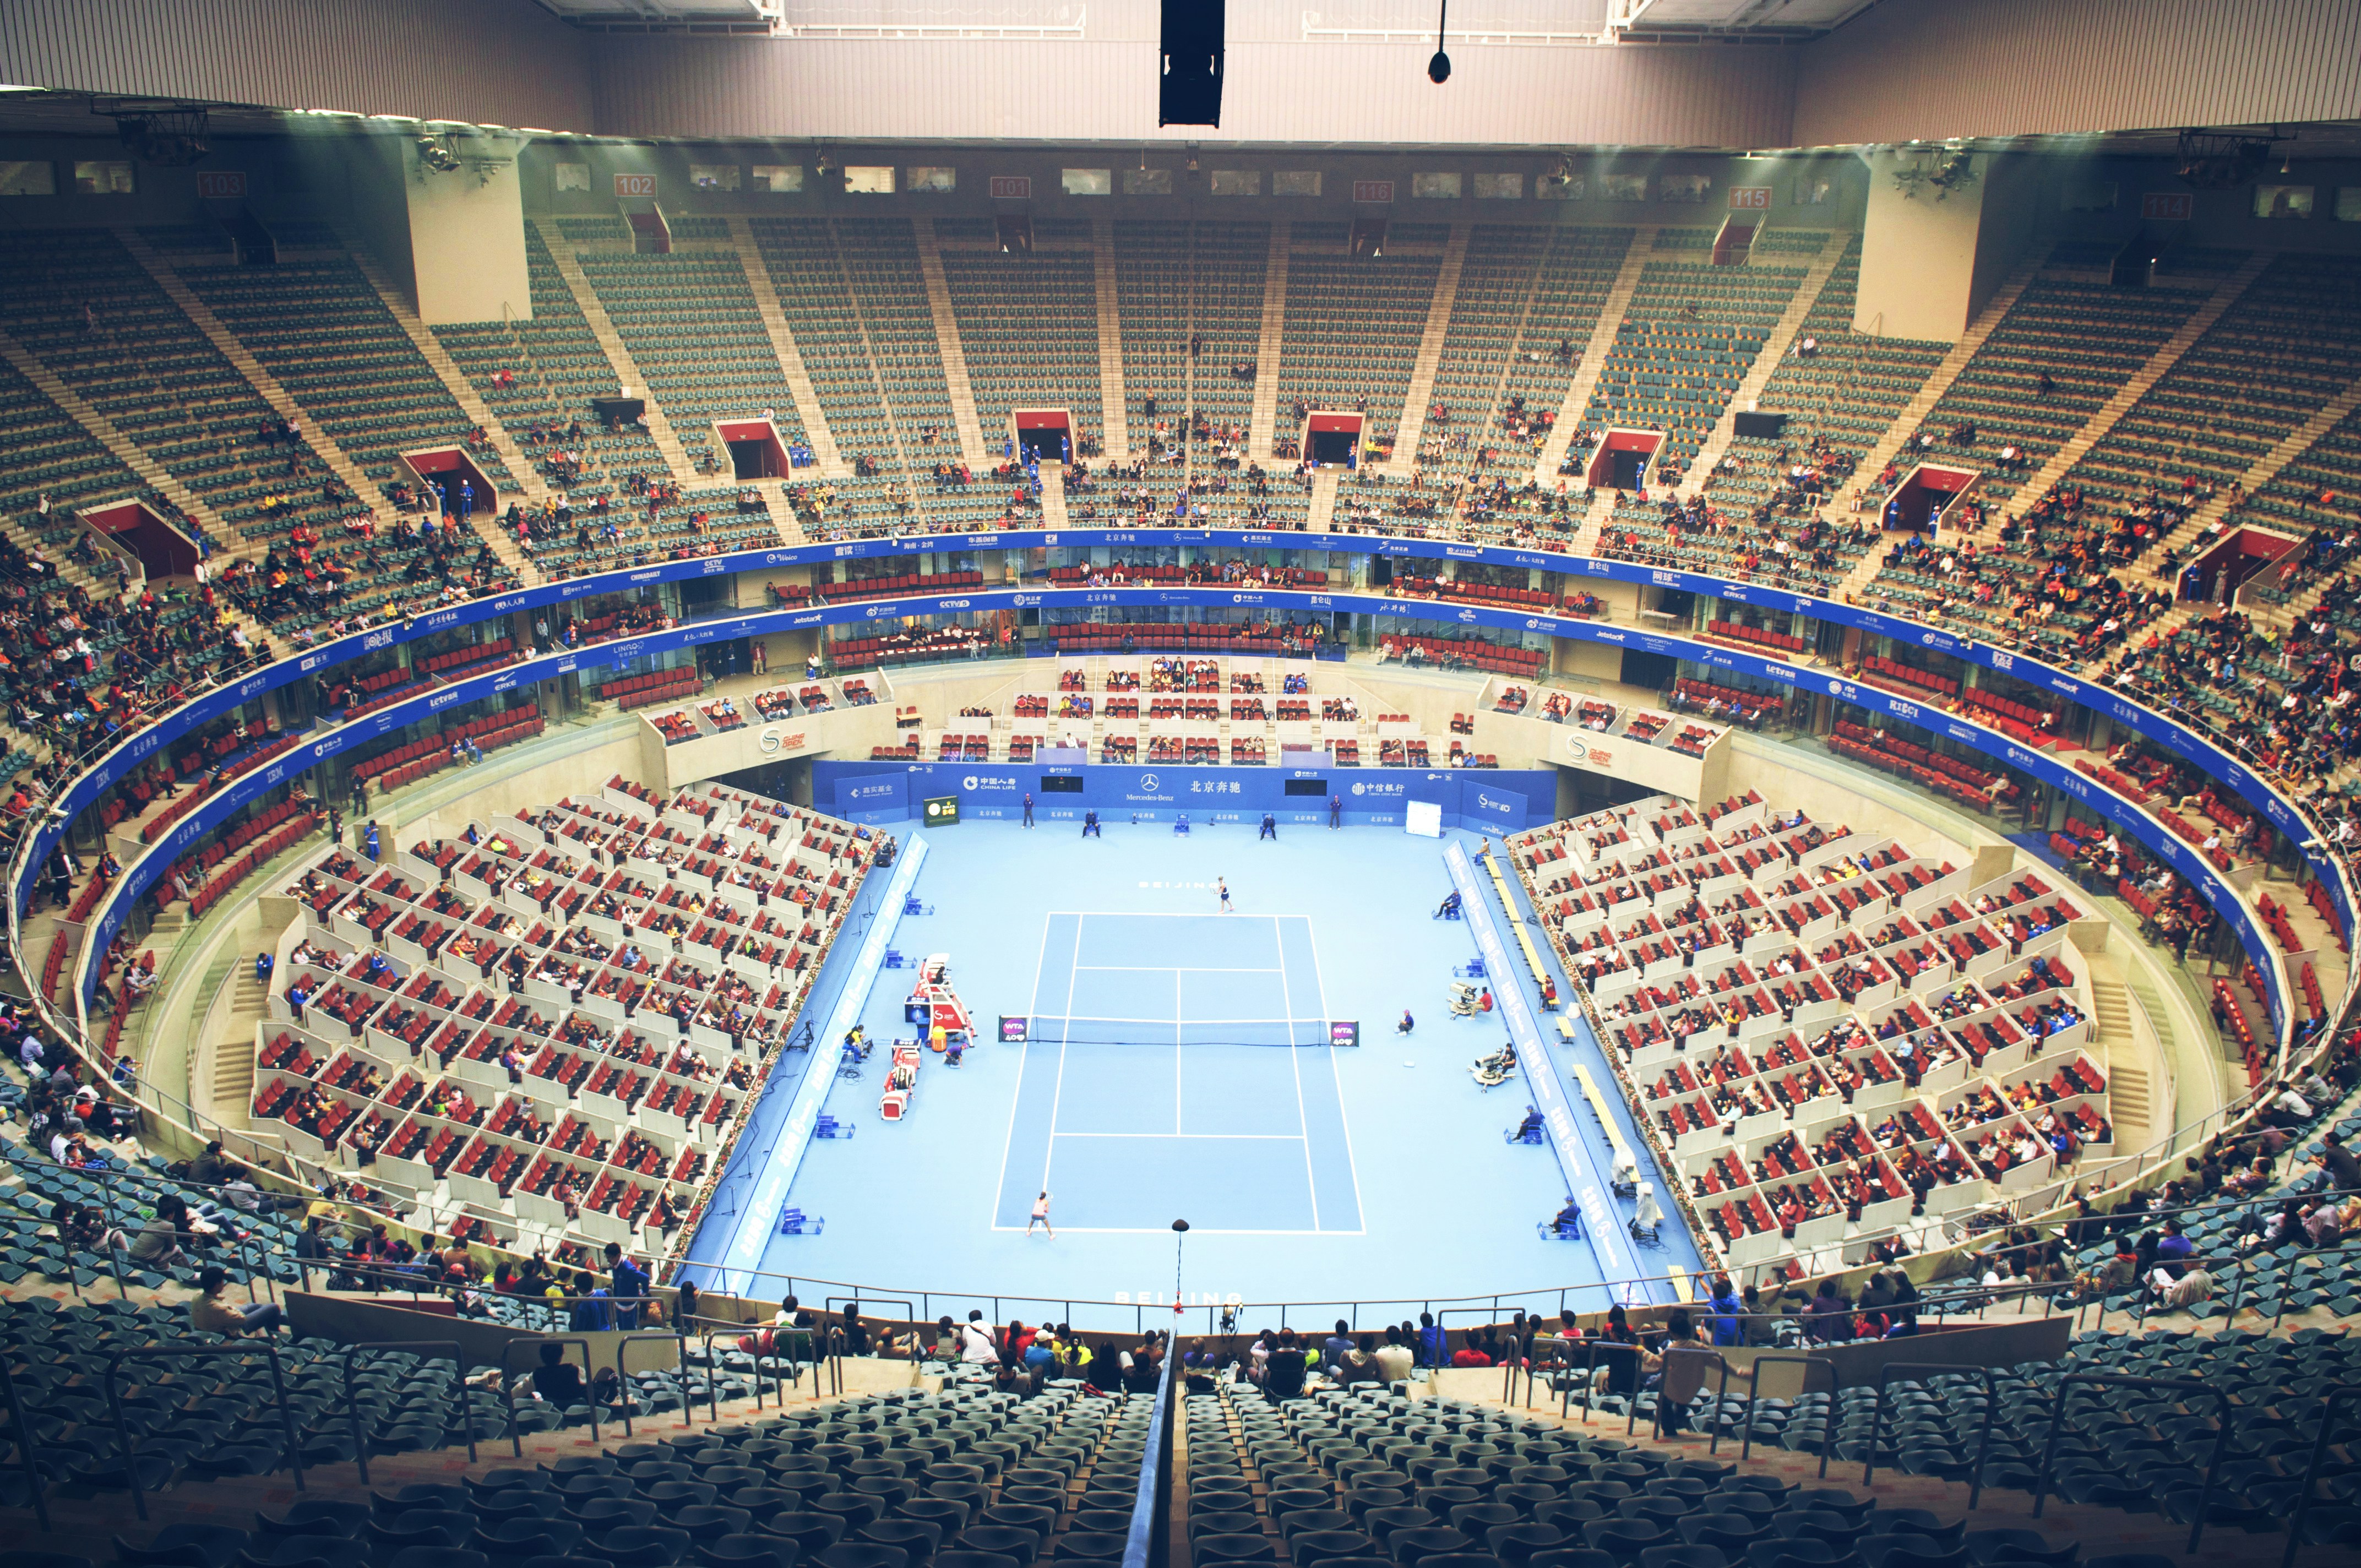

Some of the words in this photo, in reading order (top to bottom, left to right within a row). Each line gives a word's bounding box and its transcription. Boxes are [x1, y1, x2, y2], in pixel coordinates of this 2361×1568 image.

[204, 176, 240, 193] 103
[620, 177, 652, 193] 102
[997, 180, 1024, 194] 101
[1359, 184, 1387, 199] 116
[1734, 190, 1765, 206] 115
[2148, 197, 2184, 216] 114
[1587, 560, 1610, 573] 昆仑山
[1310, 595, 1332, 606] 昆仑山
[793, 616, 817, 624] Jetstar
[613, 643, 638, 654] LINGO
[494, 679, 517, 692] ERKE
[782, 739, 802, 748] OPEN
[863, 784, 893, 794] 嘉实基金
[1191, 781, 1240, 793] 北京奔驰
[1366, 782, 1406, 793] 中信银行
[1139, 881, 1219, 889] BEIJING
[1114, 1292, 1242, 1305] BEIJING
